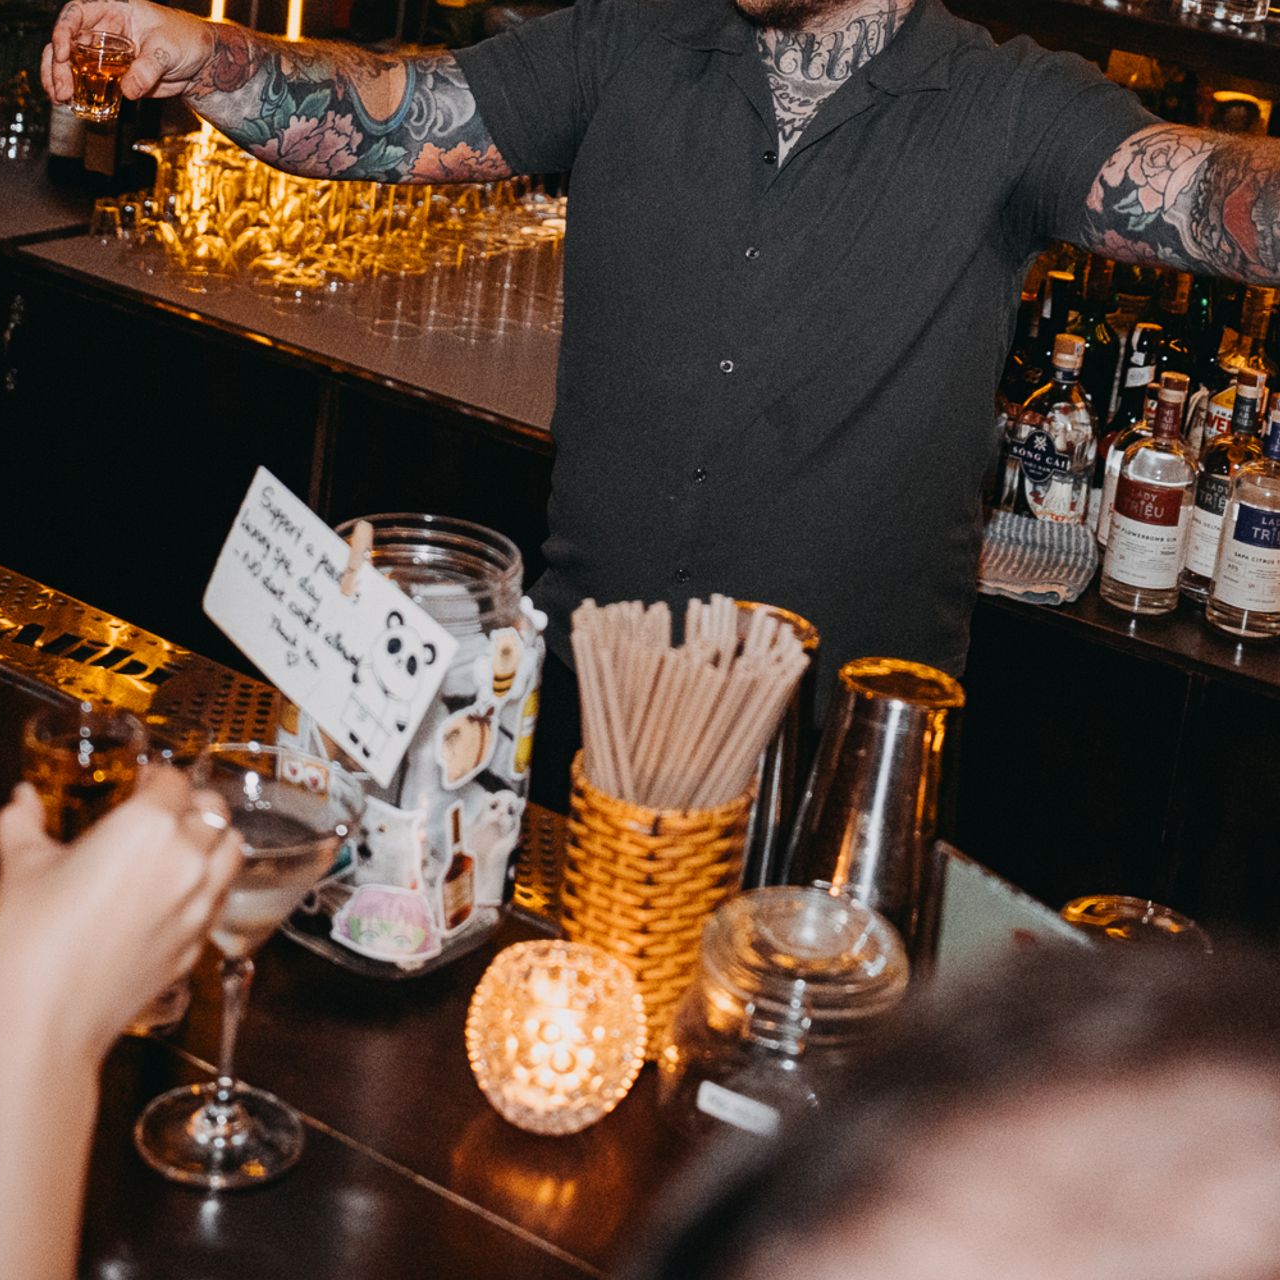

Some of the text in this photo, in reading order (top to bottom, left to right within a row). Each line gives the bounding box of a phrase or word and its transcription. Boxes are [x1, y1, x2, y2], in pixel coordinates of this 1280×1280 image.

[260, 486, 303, 543] Support
[1234, 551, 1250, 561] SAPA
[1251, 556, 1275, 566] CITRUS
